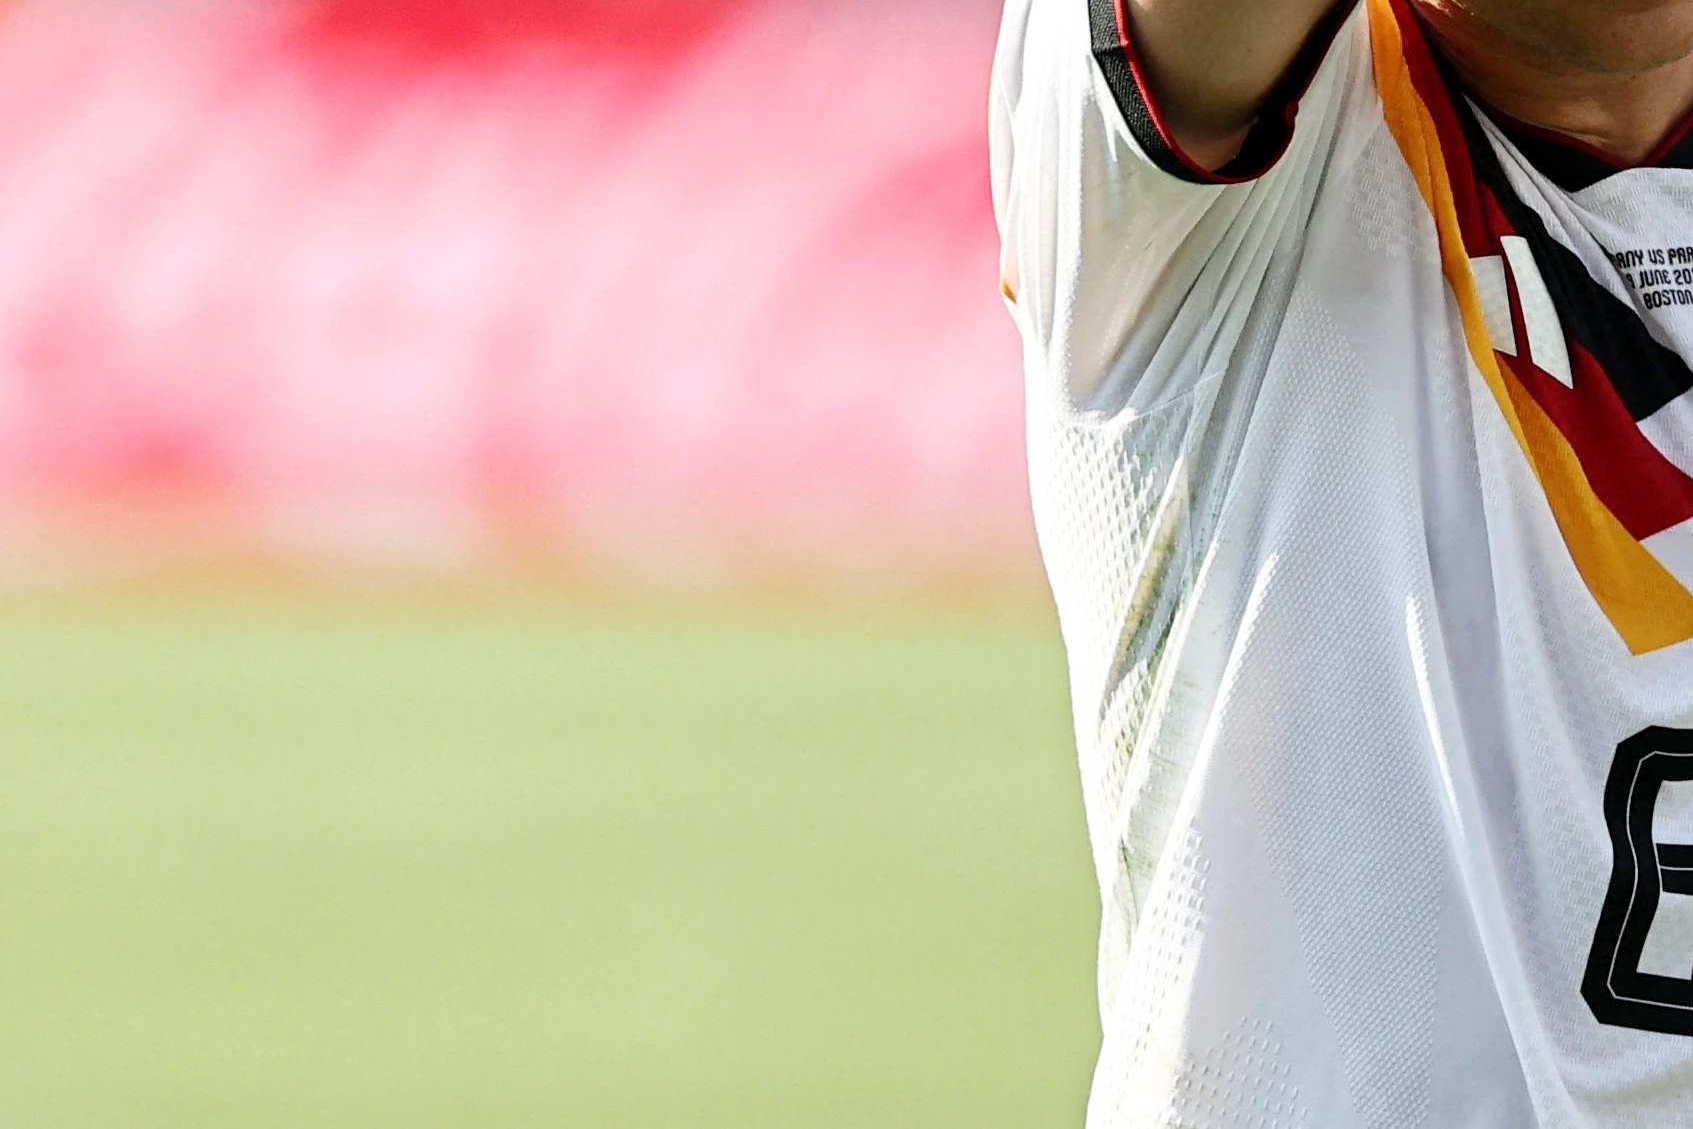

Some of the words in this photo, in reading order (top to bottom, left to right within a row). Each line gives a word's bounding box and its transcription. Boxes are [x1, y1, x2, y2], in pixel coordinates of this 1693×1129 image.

[1610, 250, 1643, 269] ANY
[1639, 269, 1671, 289] JUNE
[1642, 289, 1693, 310] BOSTON
